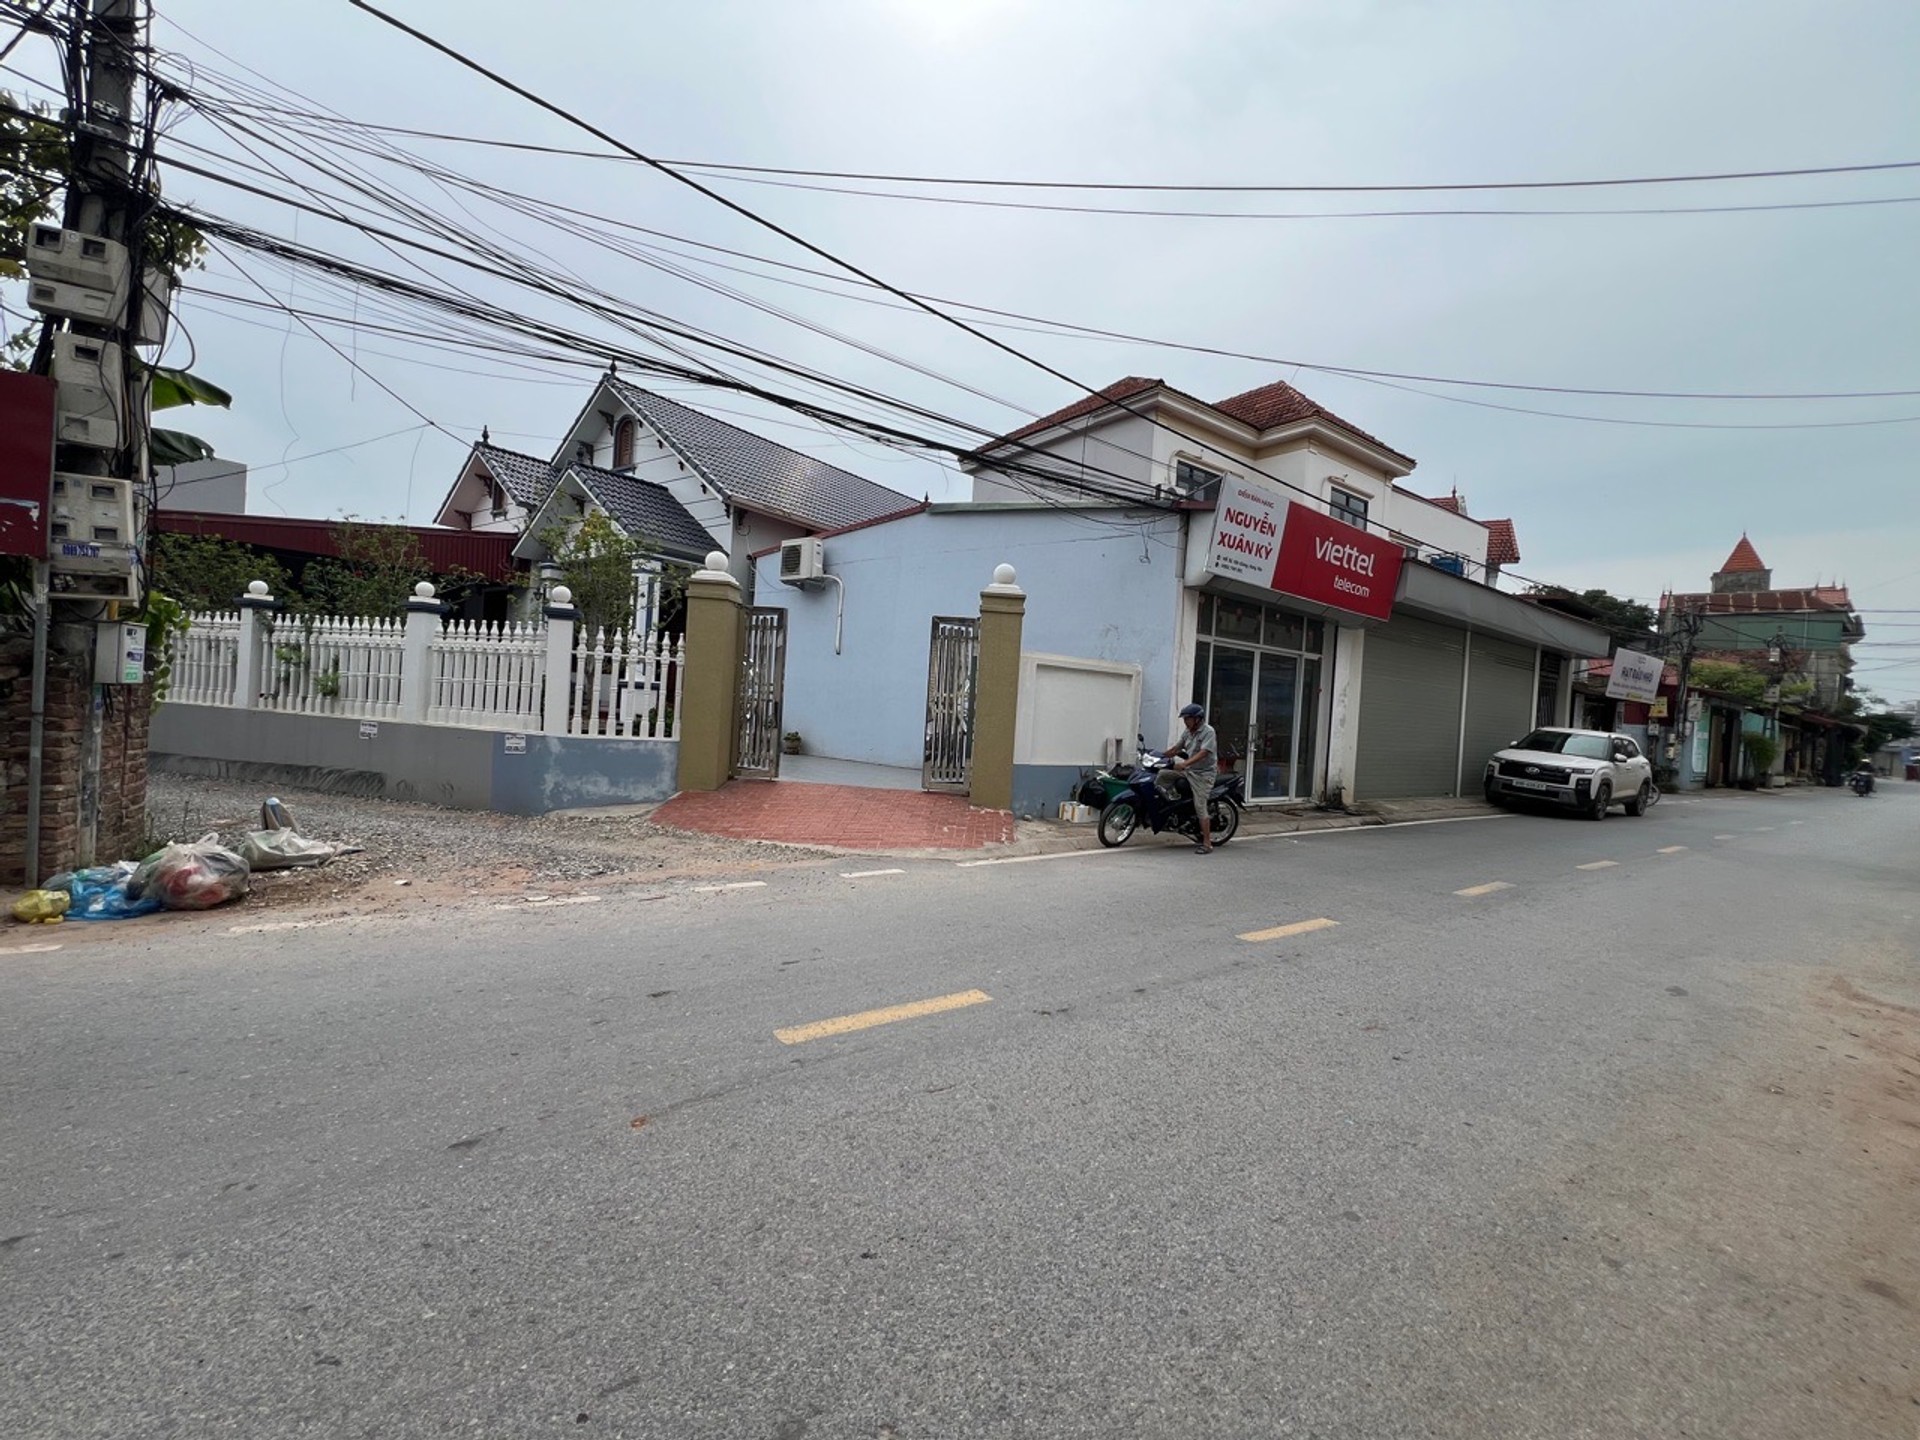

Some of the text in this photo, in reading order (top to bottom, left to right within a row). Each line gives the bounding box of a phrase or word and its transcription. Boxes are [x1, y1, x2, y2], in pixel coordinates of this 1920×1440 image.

[1224, 507, 1277, 538] NGUYỄN
[1217, 531, 1254, 555] XUÂN
[1334, 575, 1370, 597] telecom
